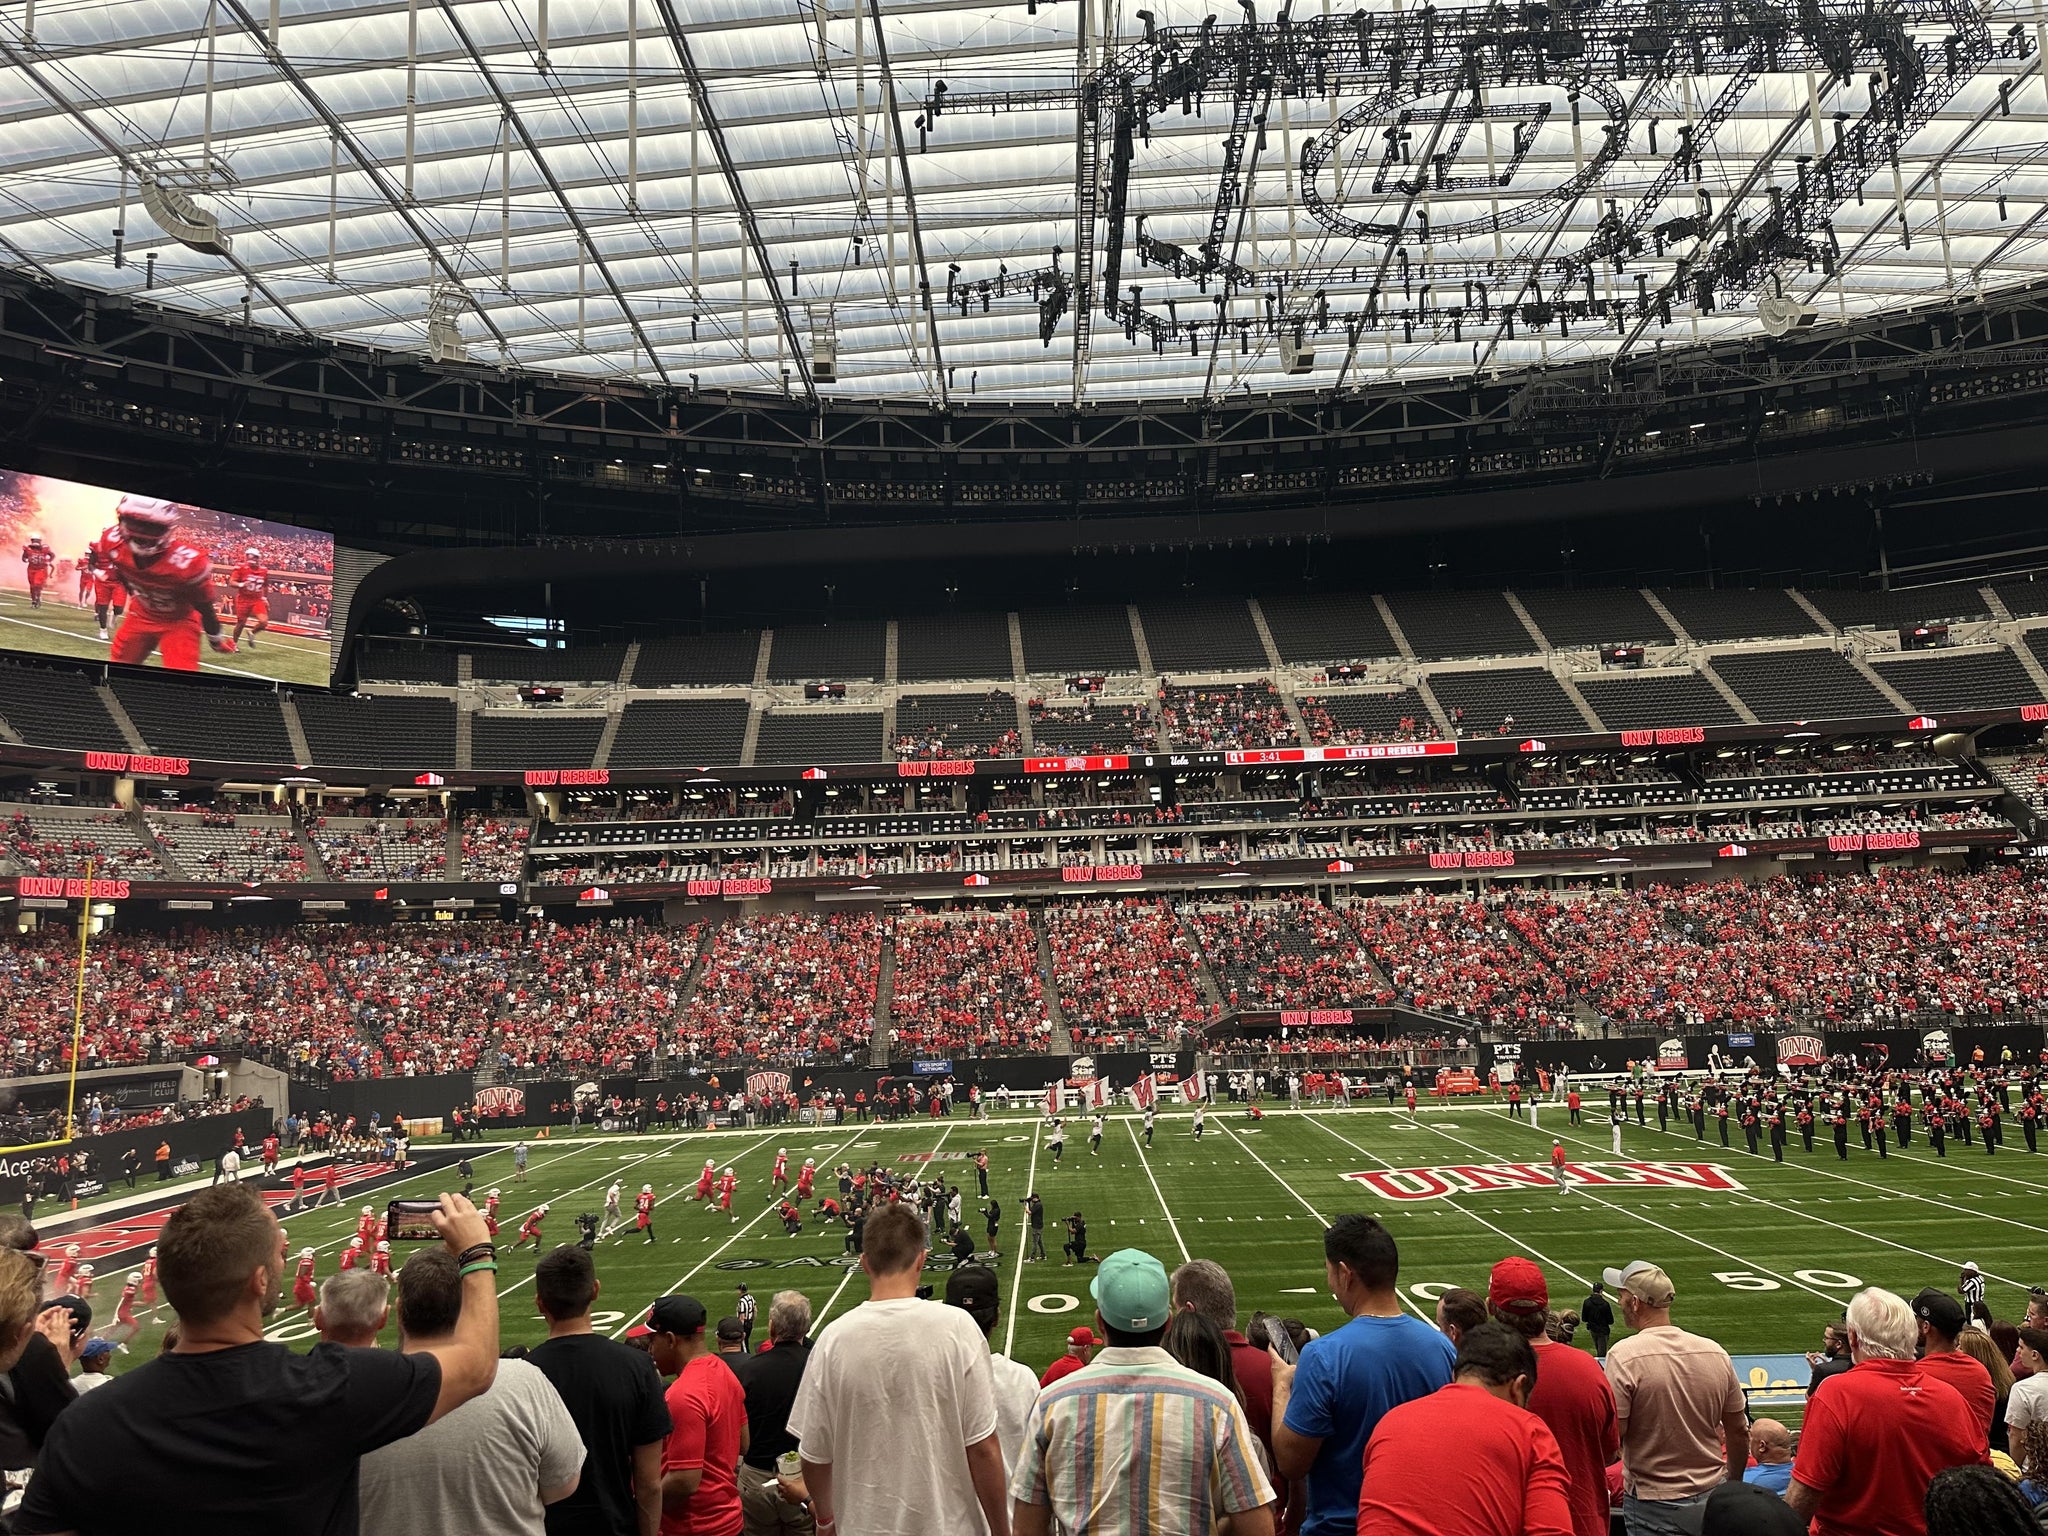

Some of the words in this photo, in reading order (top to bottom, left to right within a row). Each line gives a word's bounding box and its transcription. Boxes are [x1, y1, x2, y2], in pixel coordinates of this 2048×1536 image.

[1621, 730, 1653, 746] UNLV
[1656, 728, 1704, 745] REBELS
[1230, 754, 1245, 762] Q1
[1260, 752, 1281, 761] 3:41
[1345, 748, 1369, 758] LETS
[1371, 747, 1385, 757] GO
[1387, 745, 1426, 756] REBELS
[87, 752, 128, 771] UNLV
[130, 755, 189, 775] REBELS
[898, 761, 928, 777] UNLV
[930, 760, 975, 775] REBELS
[1064, 758, 1087, 771] UNLV
[1104, 758, 1112, 768] 0
[1146, 756, 1154, 766] 0
[525, 770, 558, 785] UNLV
[560, 769, 609, 784] REBELS
[1828, 834, 1863, 851] UNLV
[1866, 832, 1920, 850] REBELS
[1430, 853, 1462, 869] UNLV
[1465, 851, 1514, 867] REBELS
[1063, 866, 1093, 882] UNLV
[1096, 865, 1142, 881] REBELS
[20, 877, 64, 896] UNLV
[688, 880, 720, 896] UNLV
[723, 878, 771, 894] REBELS
[435, 911, 454, 920] fuku
[1281, 1011, 1308, 1026] UNLV
[1311, 1010, 1353, 1024] REBELS
[1493, 1044, 1521, 1054] PT'S
[1777, 1035, 1823, 1061] UNLV
[1150, 1053, 1176, 1064] PT'S
[154, 1081, 176, 1089] FIELD
[154, 1088, 175, 1097] CLUB
[747, 1072, 790, 1099] UNLV
[476, 1086, 523, 1113] UNLV
[723, 1180, 728, 1190] 7
[1338, 1163, 1749, 1200] UNLV
[640, 1198, 649, 1209] 24
[1711, 1269, 1864, 1290] 50
